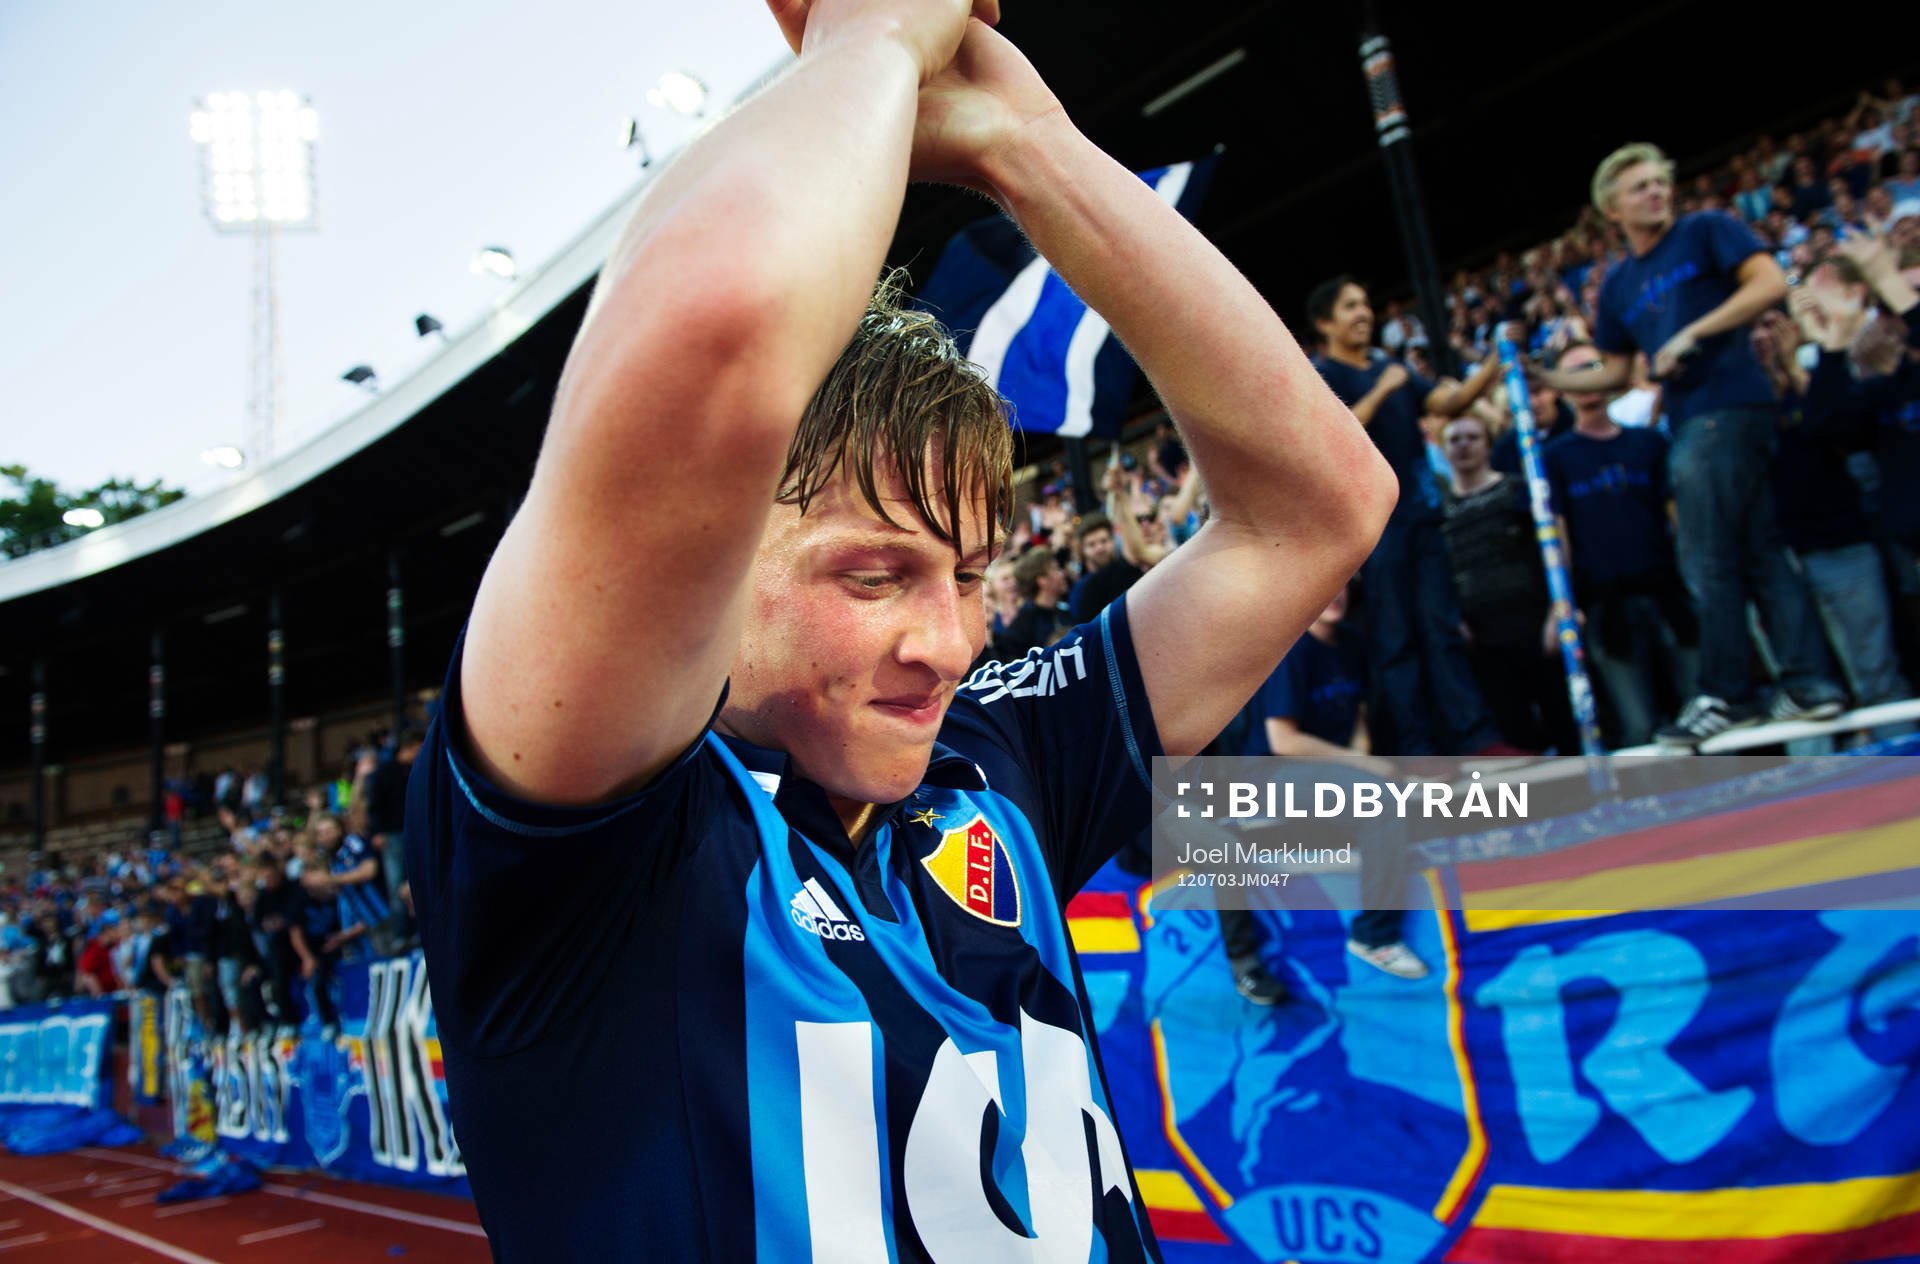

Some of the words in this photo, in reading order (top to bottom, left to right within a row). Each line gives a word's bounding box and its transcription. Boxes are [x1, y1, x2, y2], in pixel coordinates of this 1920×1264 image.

[970, 831, 991, 903] D.I.F.
[791, 908, 865, 941] adidas
[1269, 1195, 1383, 1260] UCS
